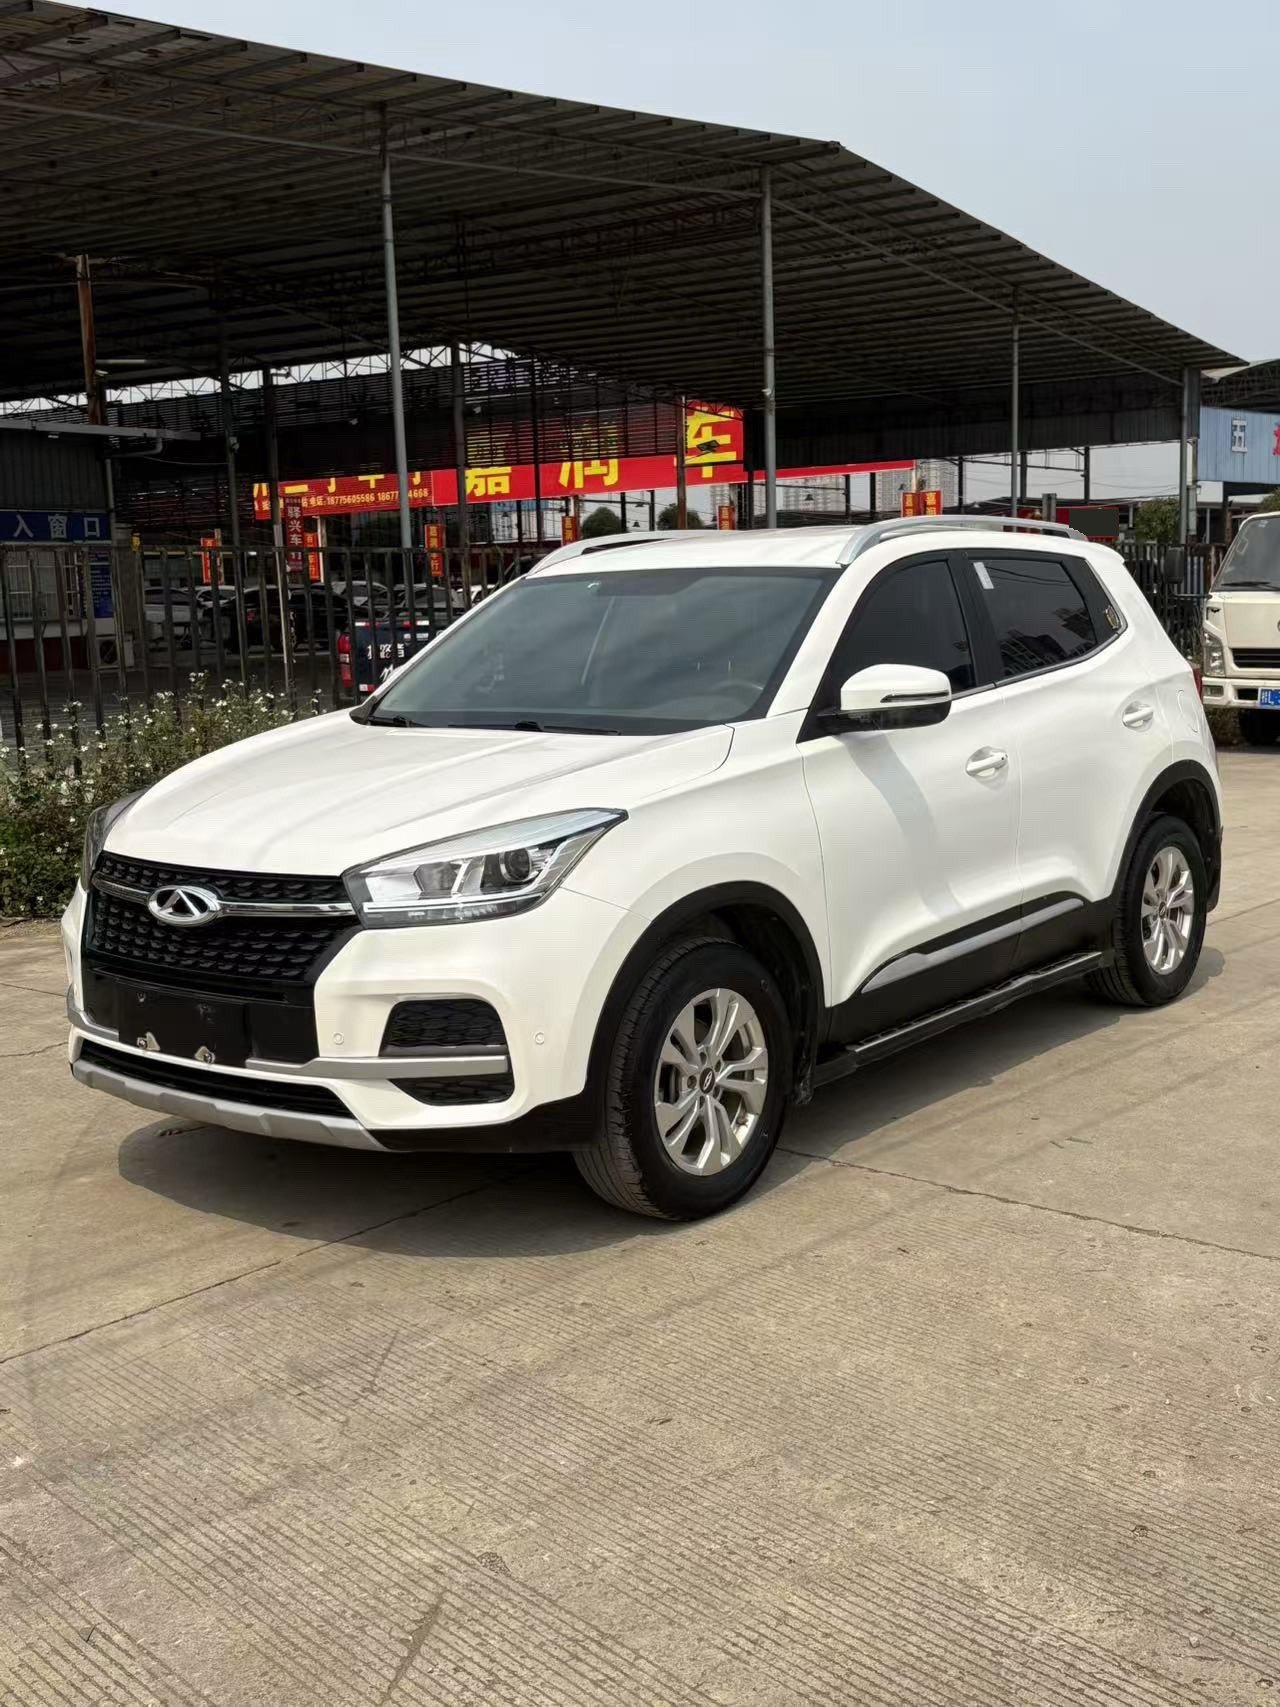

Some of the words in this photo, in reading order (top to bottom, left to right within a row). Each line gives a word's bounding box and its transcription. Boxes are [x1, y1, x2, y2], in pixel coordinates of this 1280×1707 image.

[377, 488, 429, 502] 186774668
[13, 514, 101, 539] 入窗口
